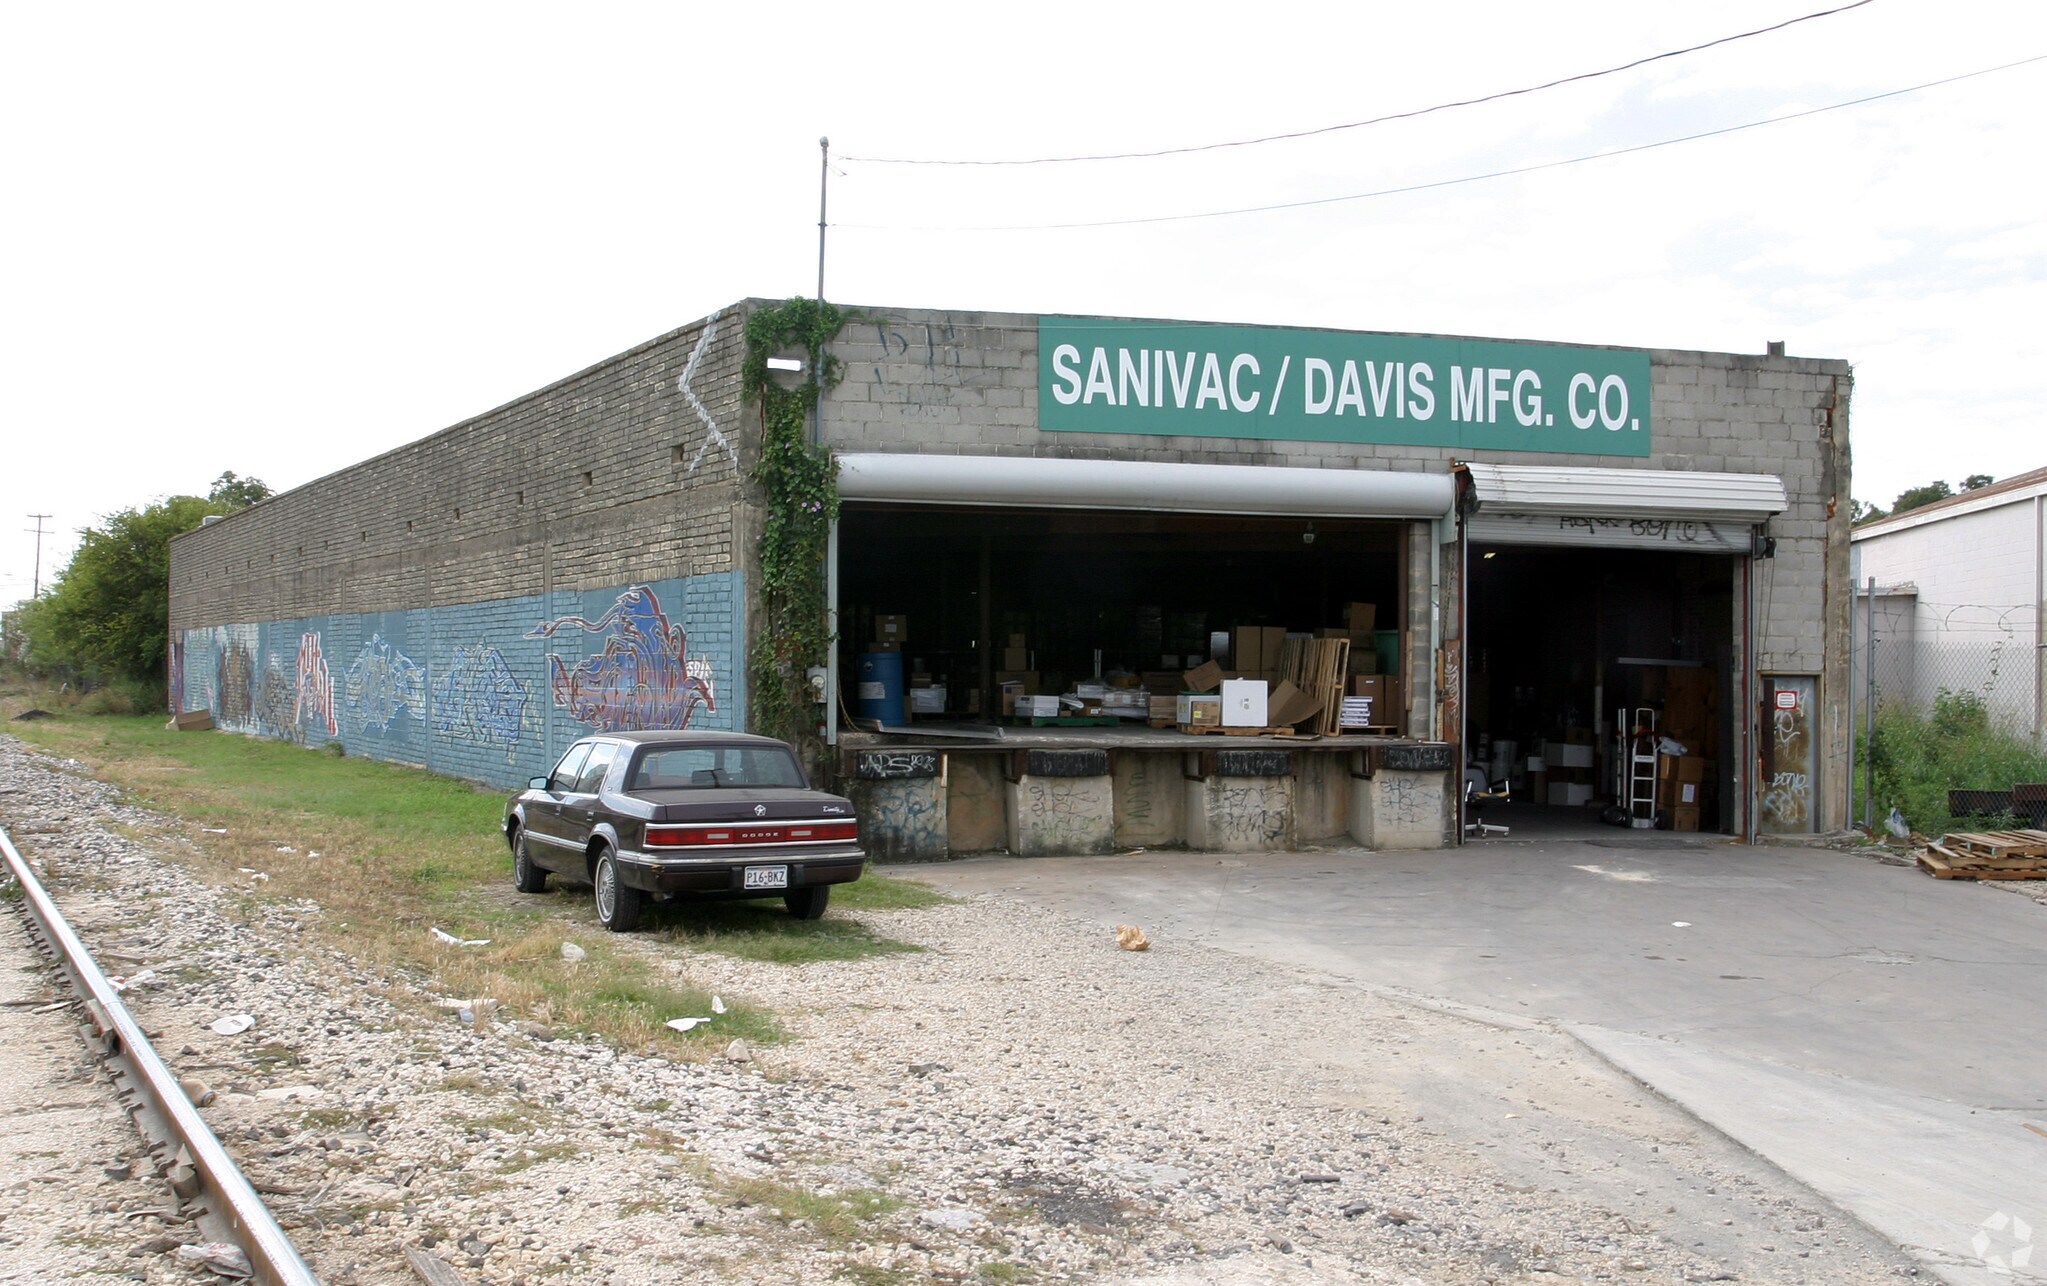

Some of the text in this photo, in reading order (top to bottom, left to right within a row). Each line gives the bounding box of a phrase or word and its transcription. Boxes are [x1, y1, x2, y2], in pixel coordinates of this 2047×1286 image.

[1051, 343, 1261, 413] SANIVAC
[1303, 357, 1435, 421] DAVIS
[1450, 365, 1554, 427] MFG.
[1567, 372, 1639, 431] CO.
